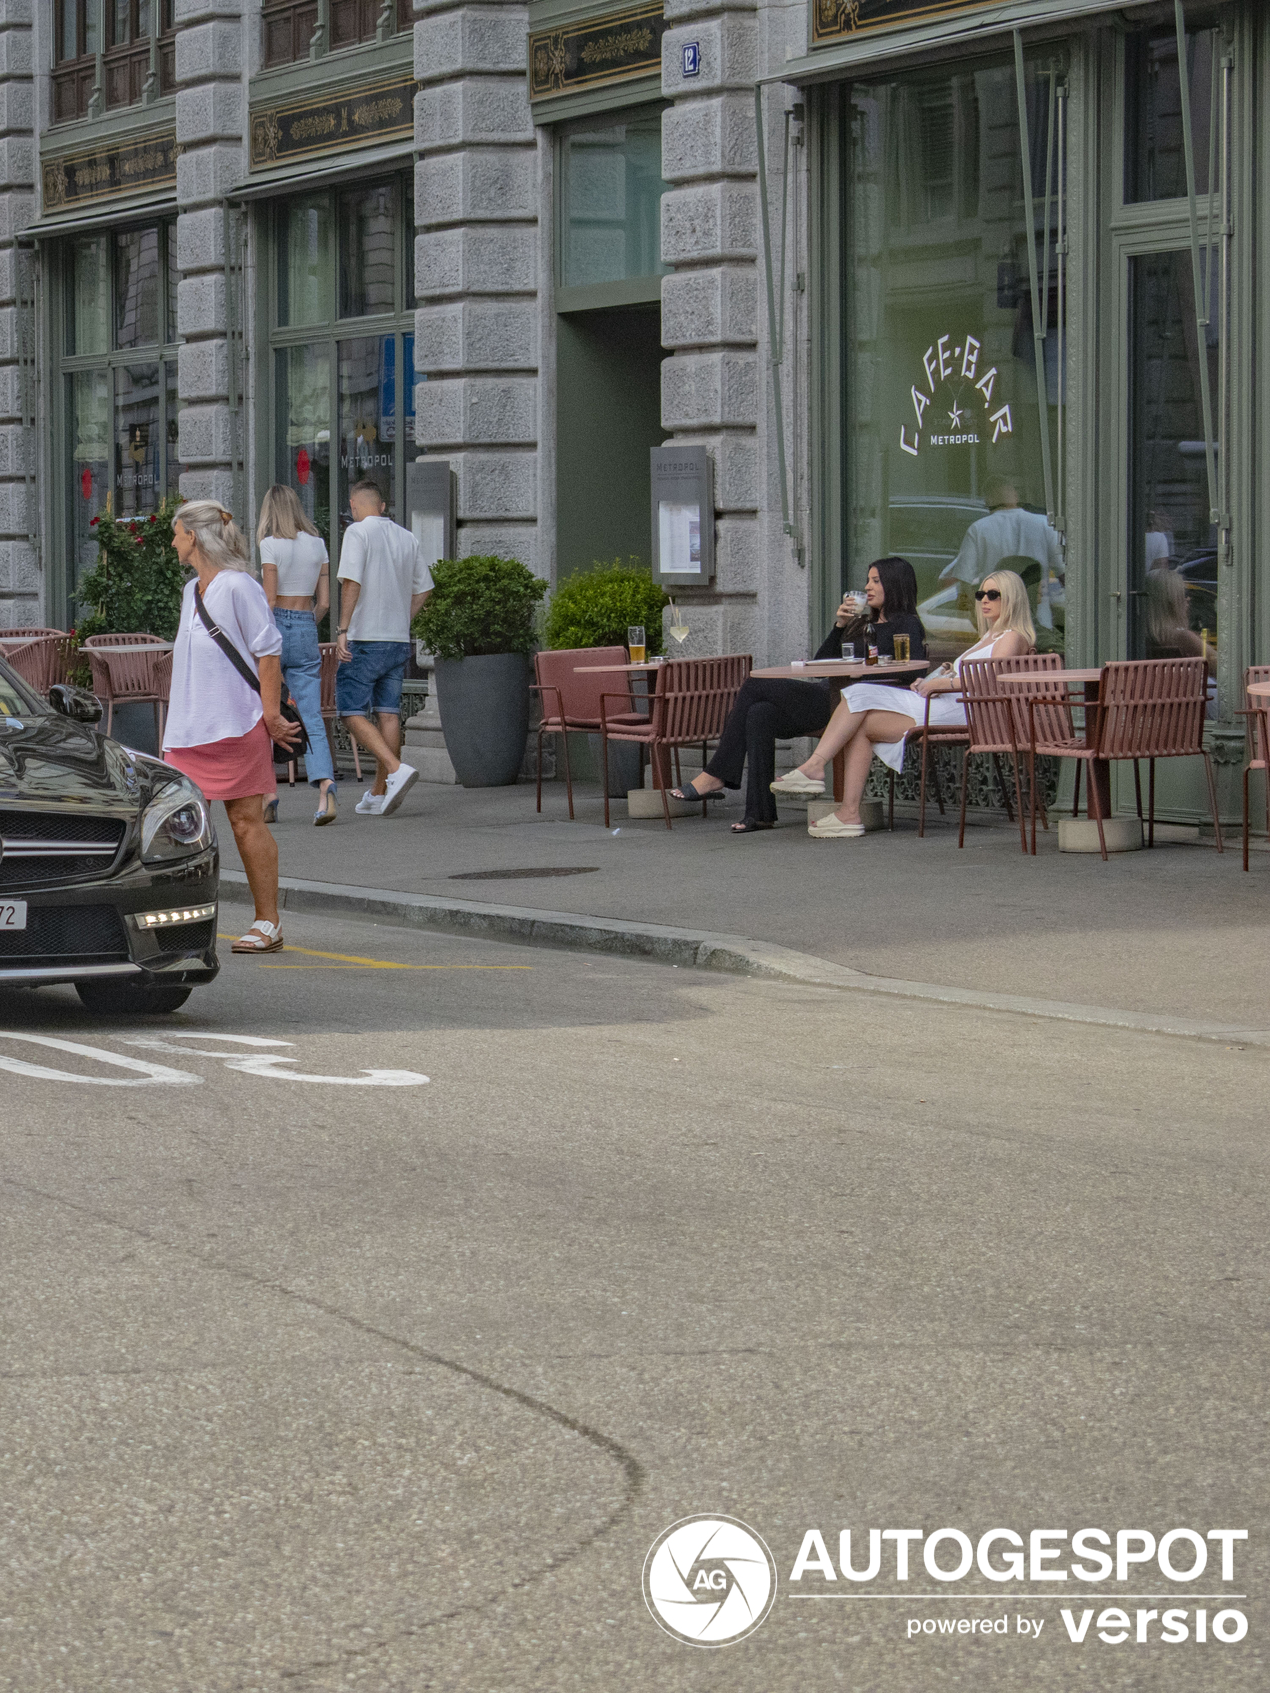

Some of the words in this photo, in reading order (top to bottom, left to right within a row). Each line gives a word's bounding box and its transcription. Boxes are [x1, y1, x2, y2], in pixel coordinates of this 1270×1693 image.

[684, 48, 694, 71] 12
[930, 433, 980, 446] METROPOL
[341, 454, 393, 469] METROPOL
[116, 474, 159, 487] METROPOL
